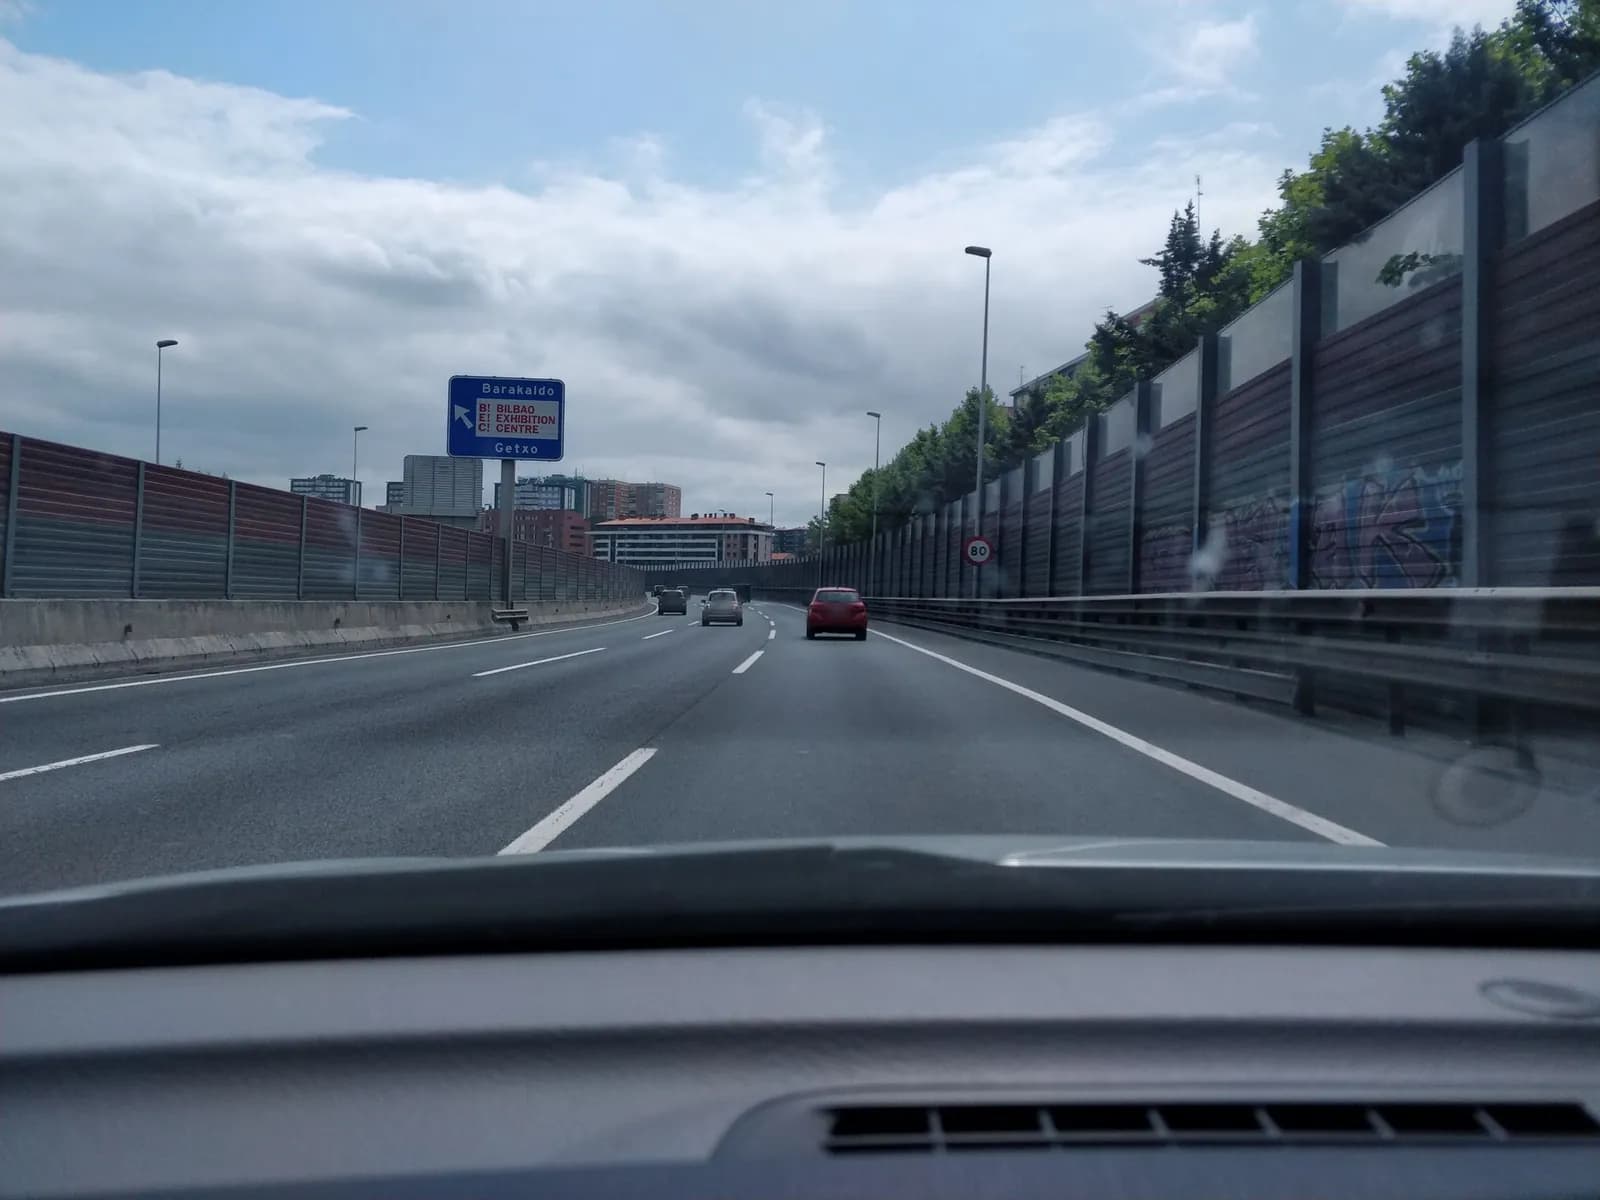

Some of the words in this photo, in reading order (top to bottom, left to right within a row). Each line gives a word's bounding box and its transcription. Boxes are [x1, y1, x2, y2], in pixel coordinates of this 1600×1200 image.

[482, 383, 554, 396] Barakaldo
[479, 403, 490, 413] B!
[496, 404, 535, 414] BILBAO
[479, 413, 490, 422] E!
[496, 414, 556, 424] EXHIBITION
[479, 423, 490, 432] C!
[496, 424, 540, 434] CENTRE
[495, 442, 538, 454] Getxo
[971, 546, 987, 556] 80
